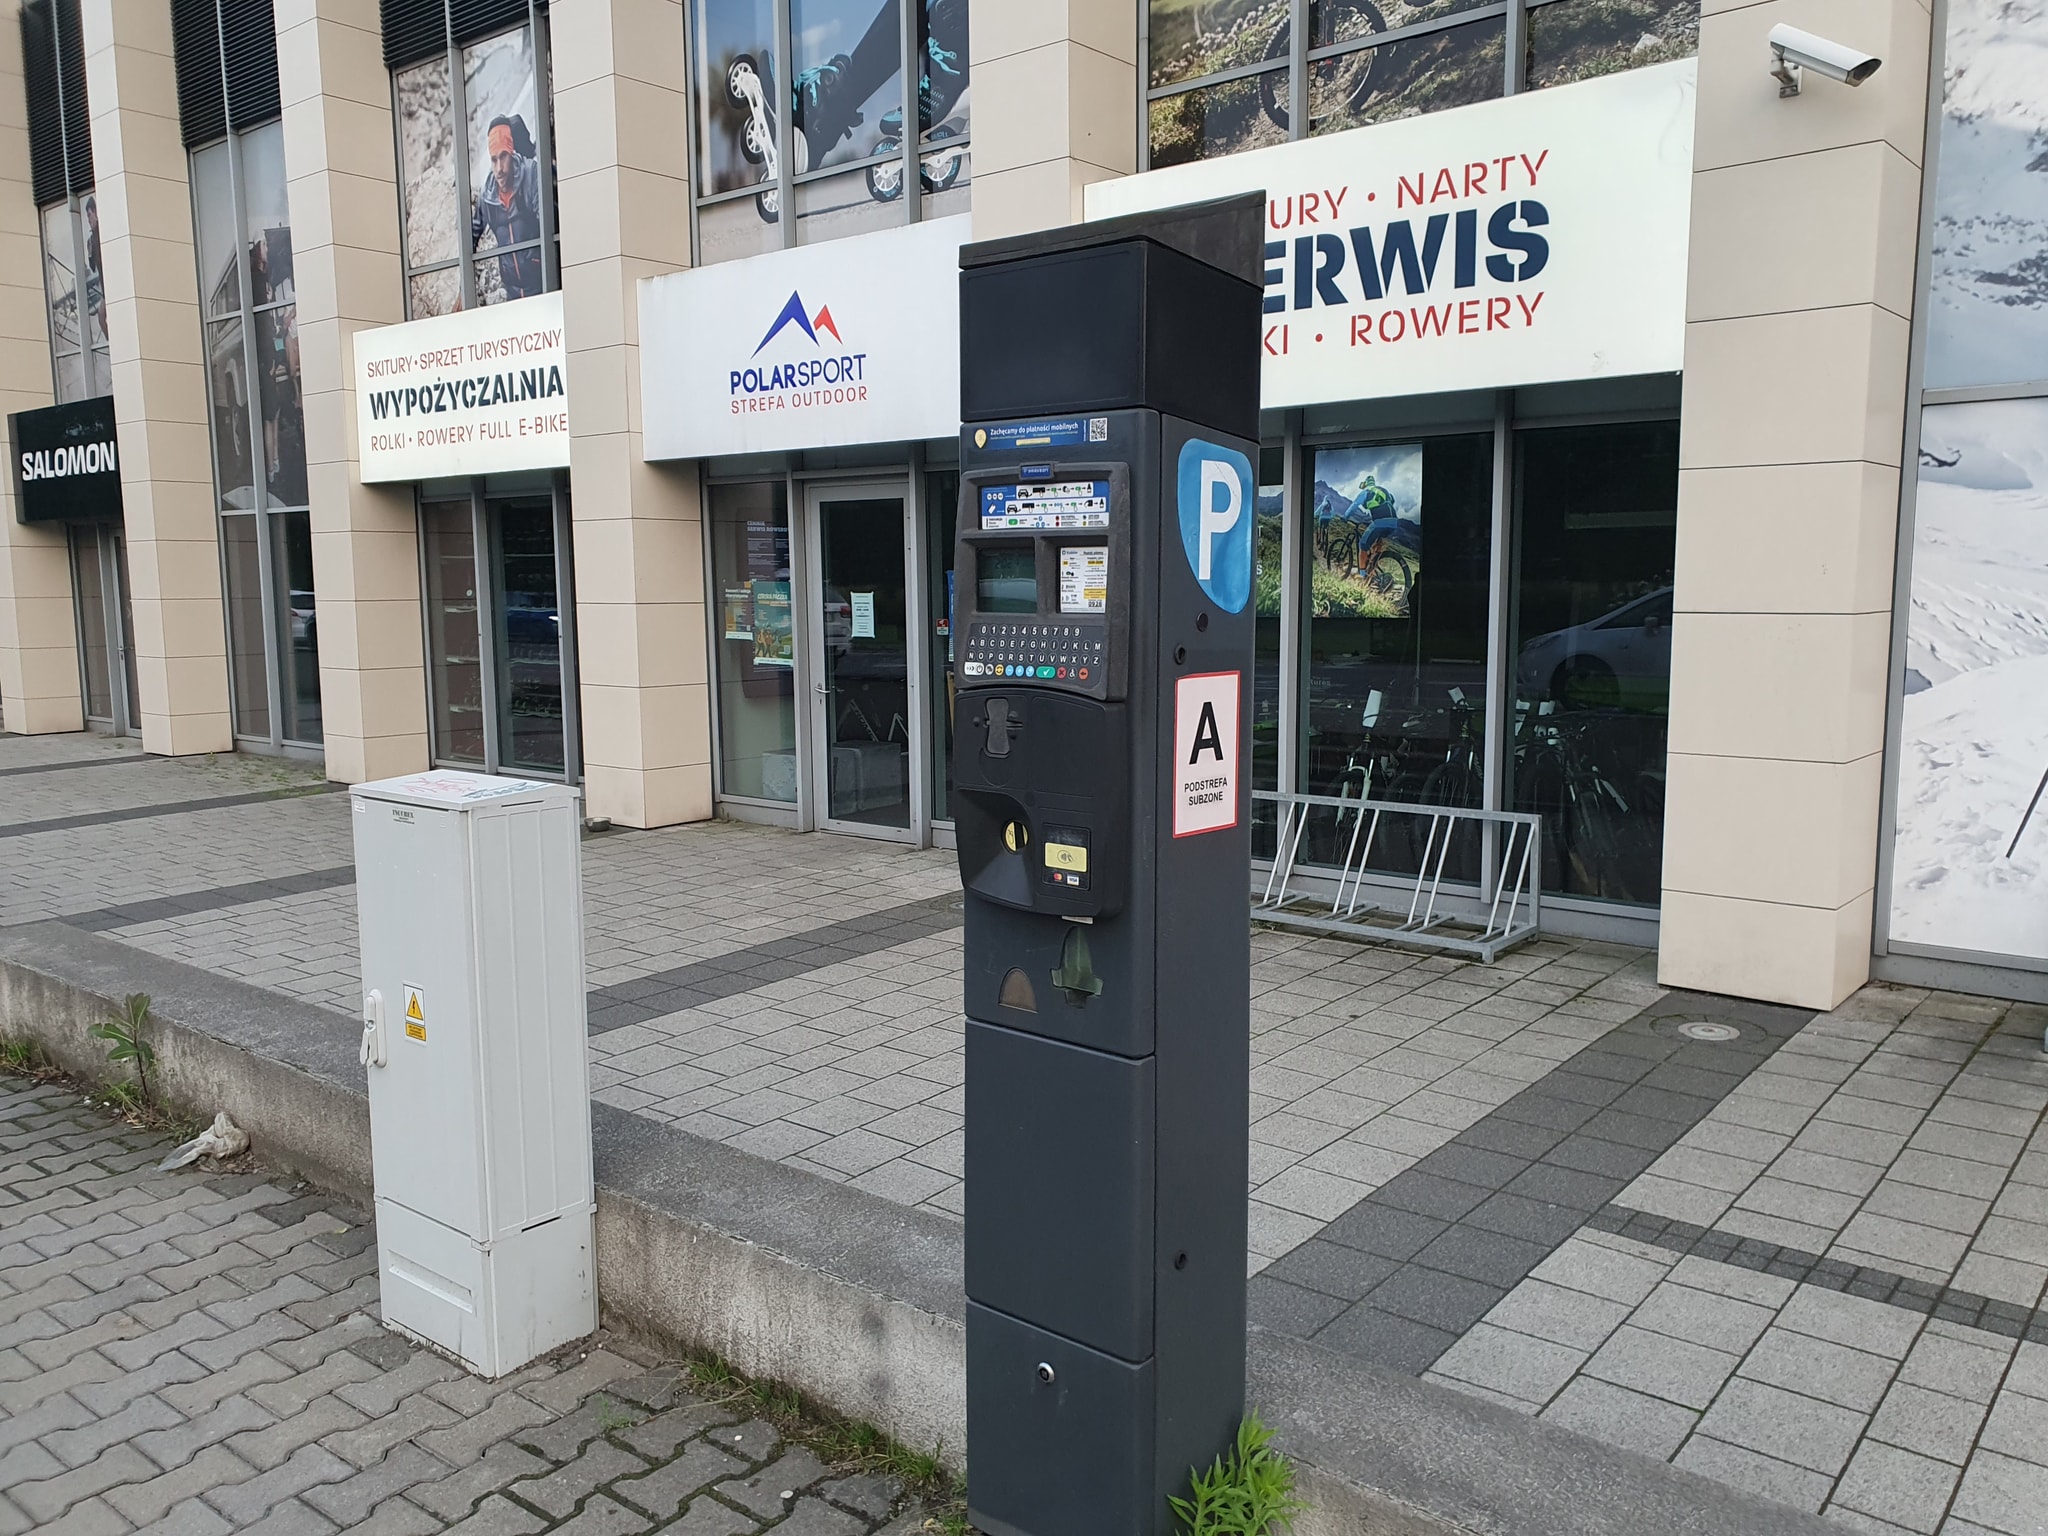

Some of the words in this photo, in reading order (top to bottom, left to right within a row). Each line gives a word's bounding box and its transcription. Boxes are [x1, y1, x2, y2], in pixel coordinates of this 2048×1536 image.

[1269, 186, 1348, 229] URY
[1397, 149, 1549, 209] NARTY
[1350, 291, 1545, 347] ROWERY
[367, 355, 412, 378] SKITURY
[419, 346, 464, 370] SPRZĘT
[467, 328, 562, 362] TURYSTYCZNY
[369, 364, 565, 420] WYPOŻYCZALNIA
[730, 354, 867, 395] POLARSPORT
[731, 394, 785, 415] STREFA
[791, 385, 868, 409] OUTDOOR
[371, 432, 406, 452] ROLKI
[417, 425, 474, 448] ROWERY
[479, 420, 512, 441] FULL
[519, 413, 568, 437] E-BIKE
[1051, 422, 1078, 432] mobilnych
[22, 440, 116, 481] SALOMON
[1198, 459, 1243, 580] P
[1188, 701, 1224, 765] A
[1184, 776, 1228, 793] PODSTREFA
[1188, 791, 1224, 806] SUBZONE
